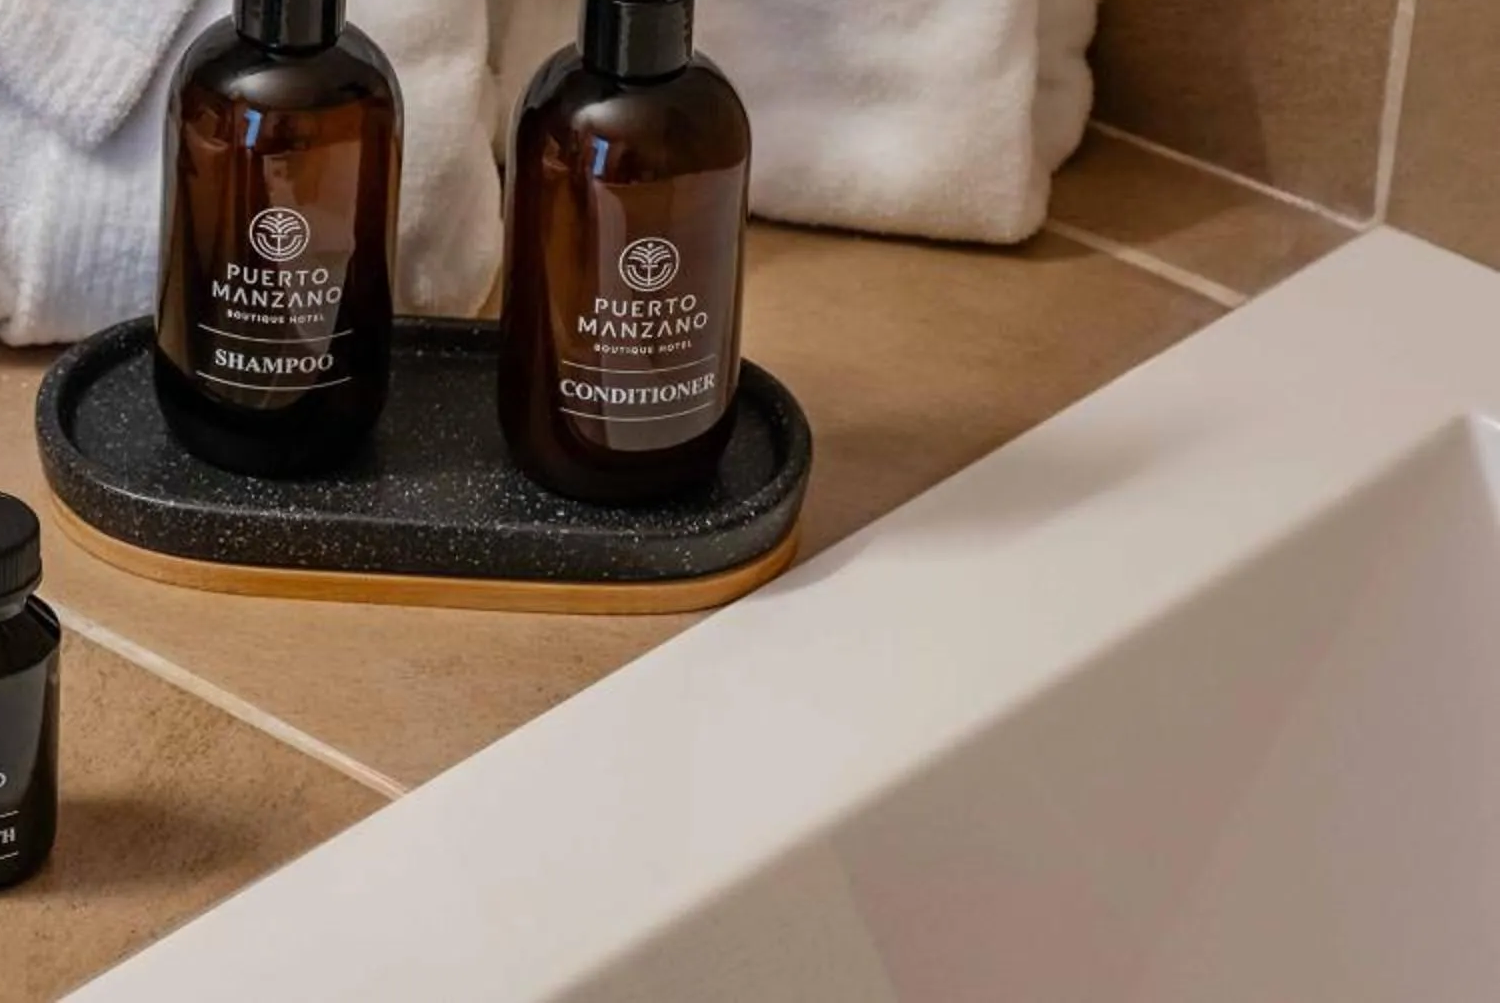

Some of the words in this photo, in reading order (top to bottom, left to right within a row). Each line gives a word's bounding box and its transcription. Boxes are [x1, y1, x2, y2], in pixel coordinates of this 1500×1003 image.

[226, 262, 329, 287] PUERTO
[211, 280, 342, 308] MANZANO
[594, 294, 697, 318] PUERTO
[227, 309, 284, 324] BOUTIQUE
[289, 314, 325, 324] HOTEL
[577, 311, 708, 339] MANZANO
[593, 343, 653, 355] BOUTIQUE
[658, 339, 692, 353] HOTEL
[214, 348, 334, 374] SHAMPOO
[559, 372, 716, 405] CONDITIONER
